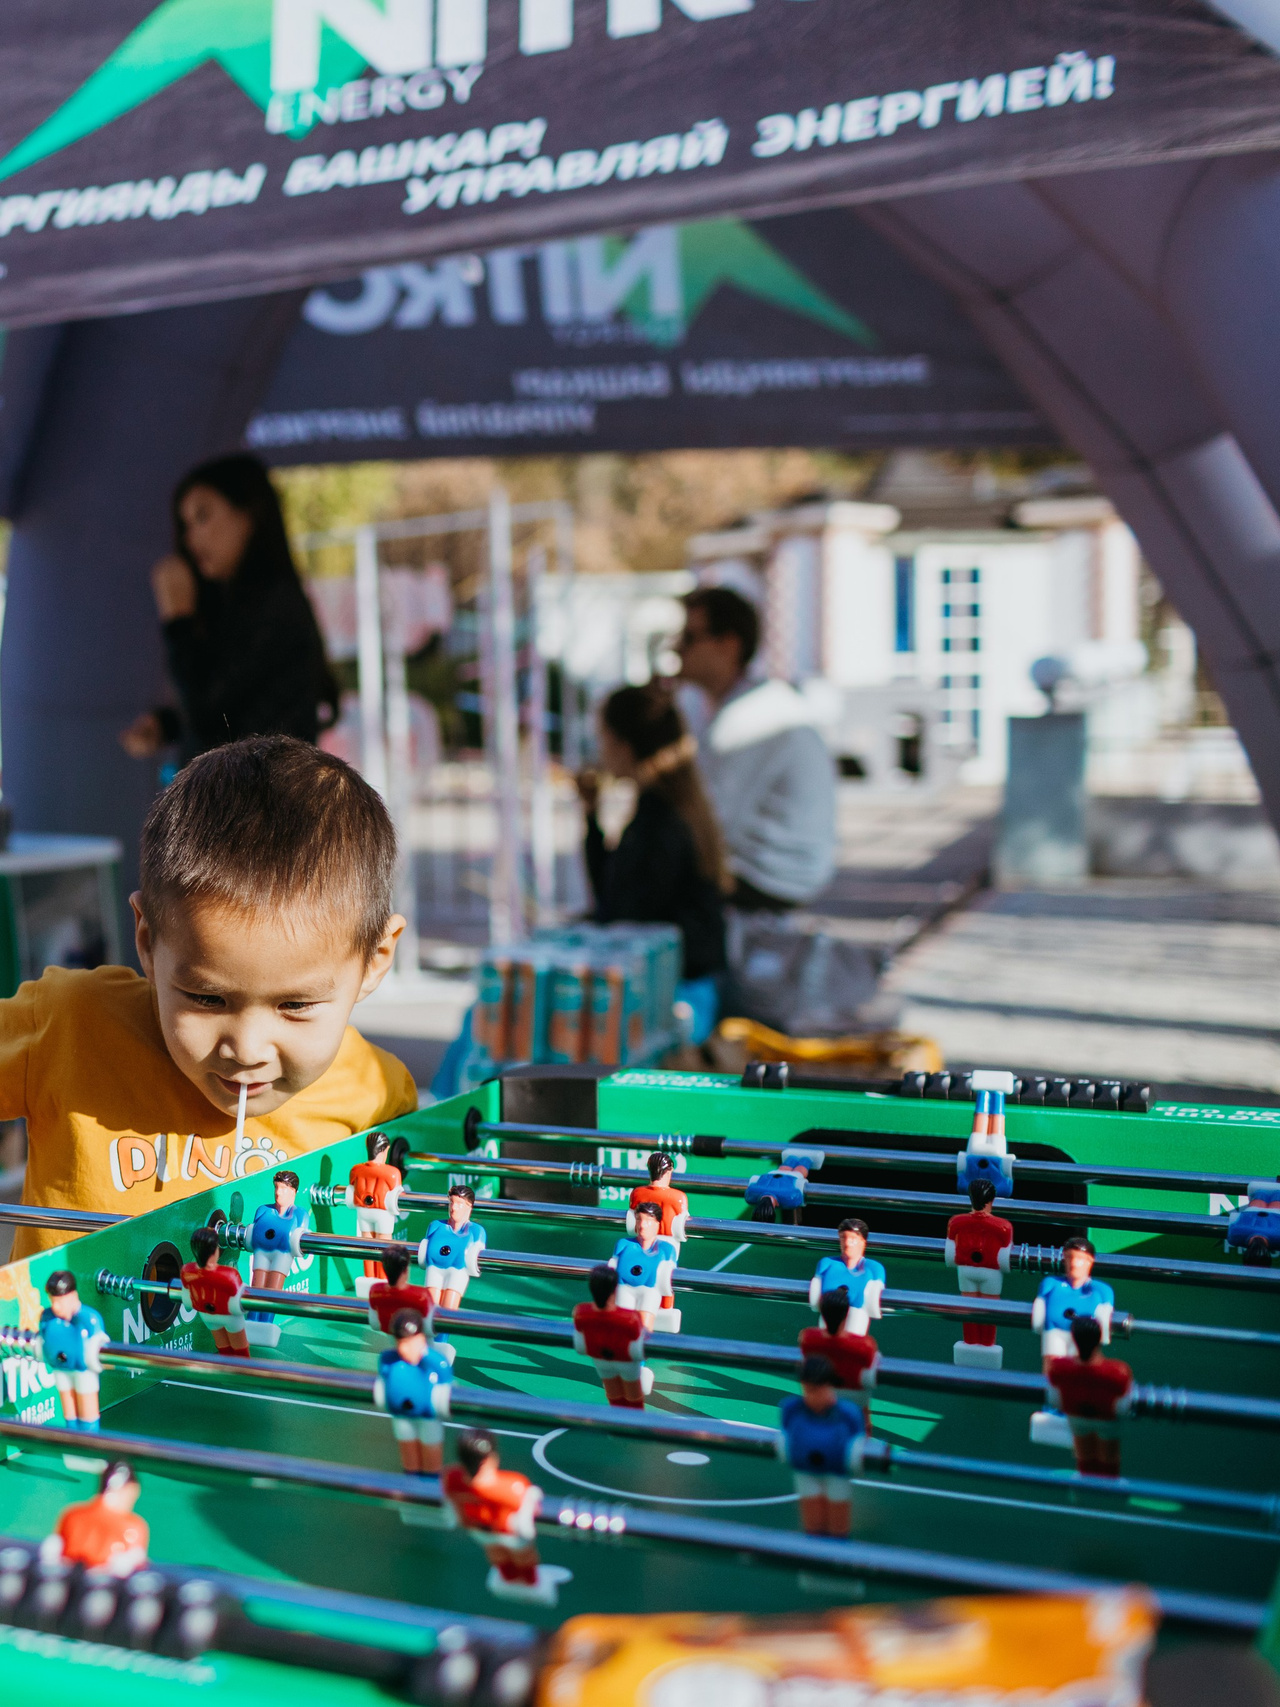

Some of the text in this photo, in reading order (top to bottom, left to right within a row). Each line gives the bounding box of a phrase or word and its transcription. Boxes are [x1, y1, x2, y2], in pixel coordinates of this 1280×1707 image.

[265, 64, 484, 134] ENERGY
[401, 50, 1116, 215] УПРАВЛЯЙ ЭНЕРГИЕЙ!
[282, 116, 548, 197] БАШКАР!
[173, 1332, 193, 1349] SOFT
[31, 1396, 55, 1417] SOFT
